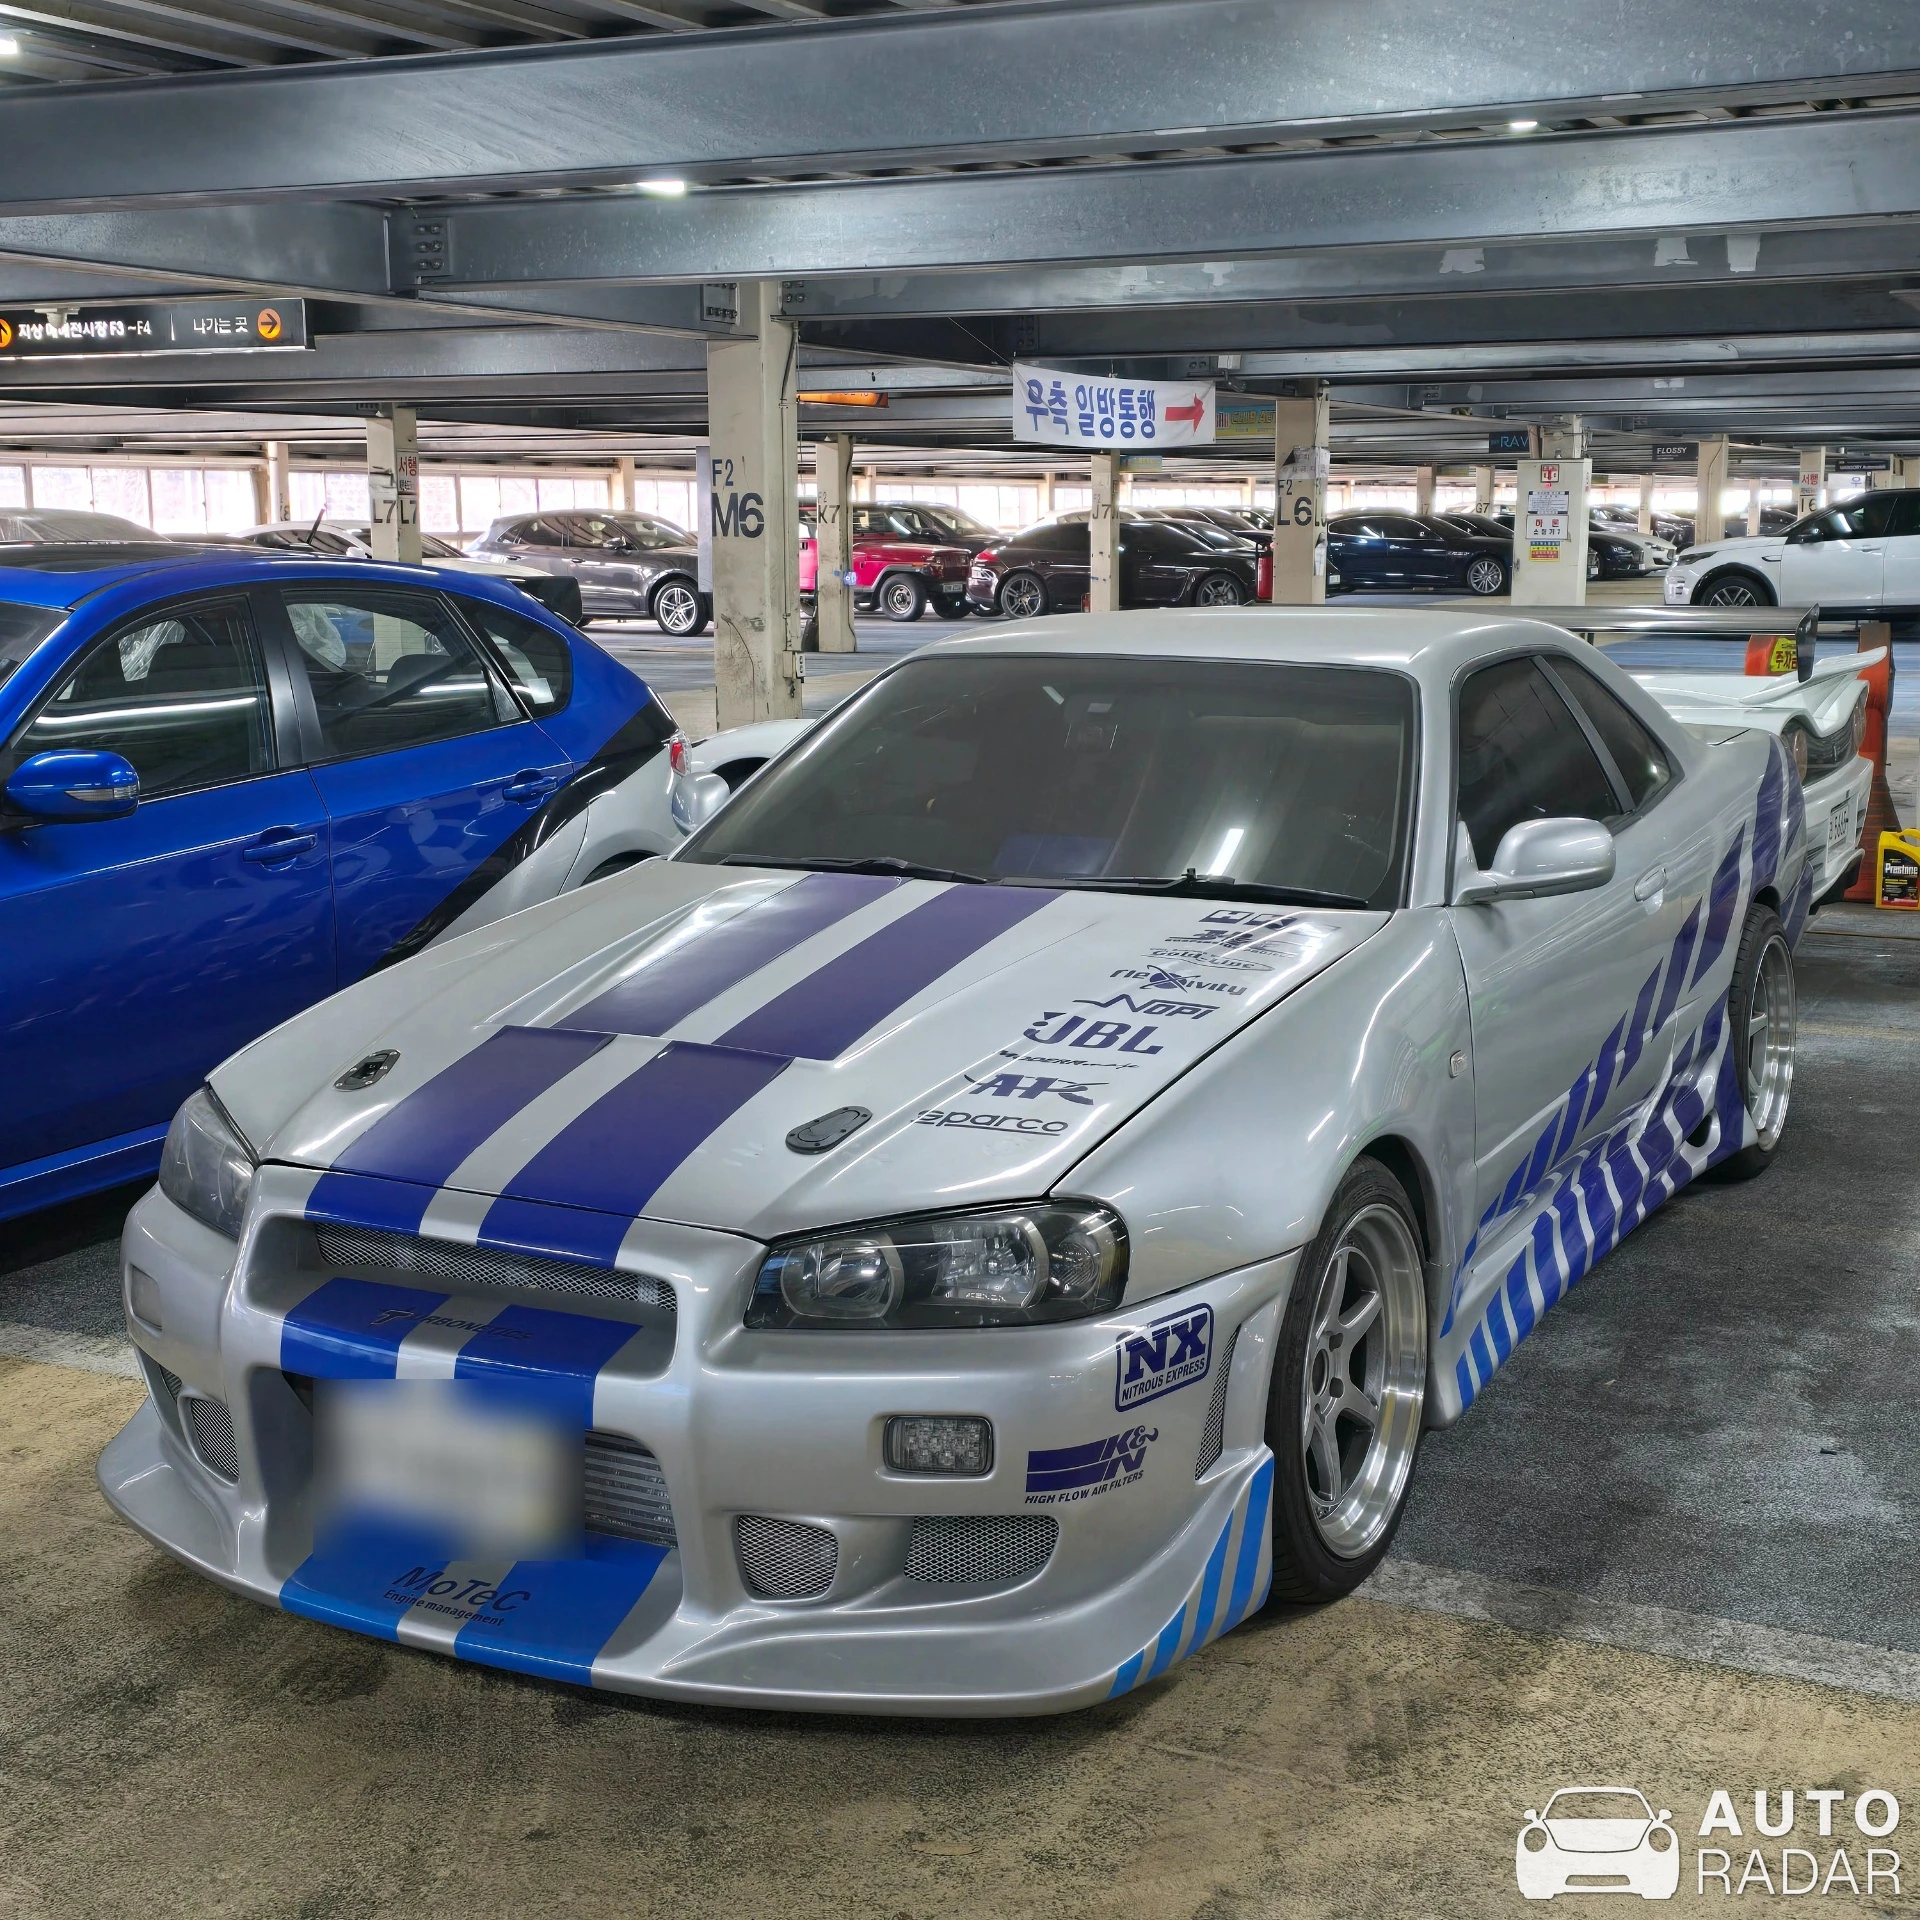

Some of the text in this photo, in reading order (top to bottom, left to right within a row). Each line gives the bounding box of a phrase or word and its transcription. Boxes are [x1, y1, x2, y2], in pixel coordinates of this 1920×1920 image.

[18, 323, 44, 340] 지상
[193, 316, 248, 335] 나가는 곳
[1026, 379, 1156, 439] 우측 일방통행
[1656, 446, 1687, 455] FLOSSY
[399, 456, 417, 476] 서행
[712, 458, 734, 487] F2
[1277, 479, 1293, 496] F2
[373, 499, 397, 524] L7
[401, 499, 417, 524] L7
[711, 492, 765, 539] M6
[818, 504, 841, 525] K7
[1092, 504, 1111, 519] J7
[1276, 496, 1312, 527] L6
[1475, 502, 1490, 514] G7
[1775, 650, 1797, 669] 주차금
[1885, 862, 1918, 875] Prestone
[1023, 1014, 1164, 1055] JBL
[1123, 1311, 1208, 1385] NX
[1121, 1357, 1206, 1402] NITROUS EXPRESS
[1025, 1469, 1144, 1504] HIGH FLOW AIR FILTERS
[391, 1566, 531, 1612] MoTeC
[383, 1589, 505, 1627] Engine management
